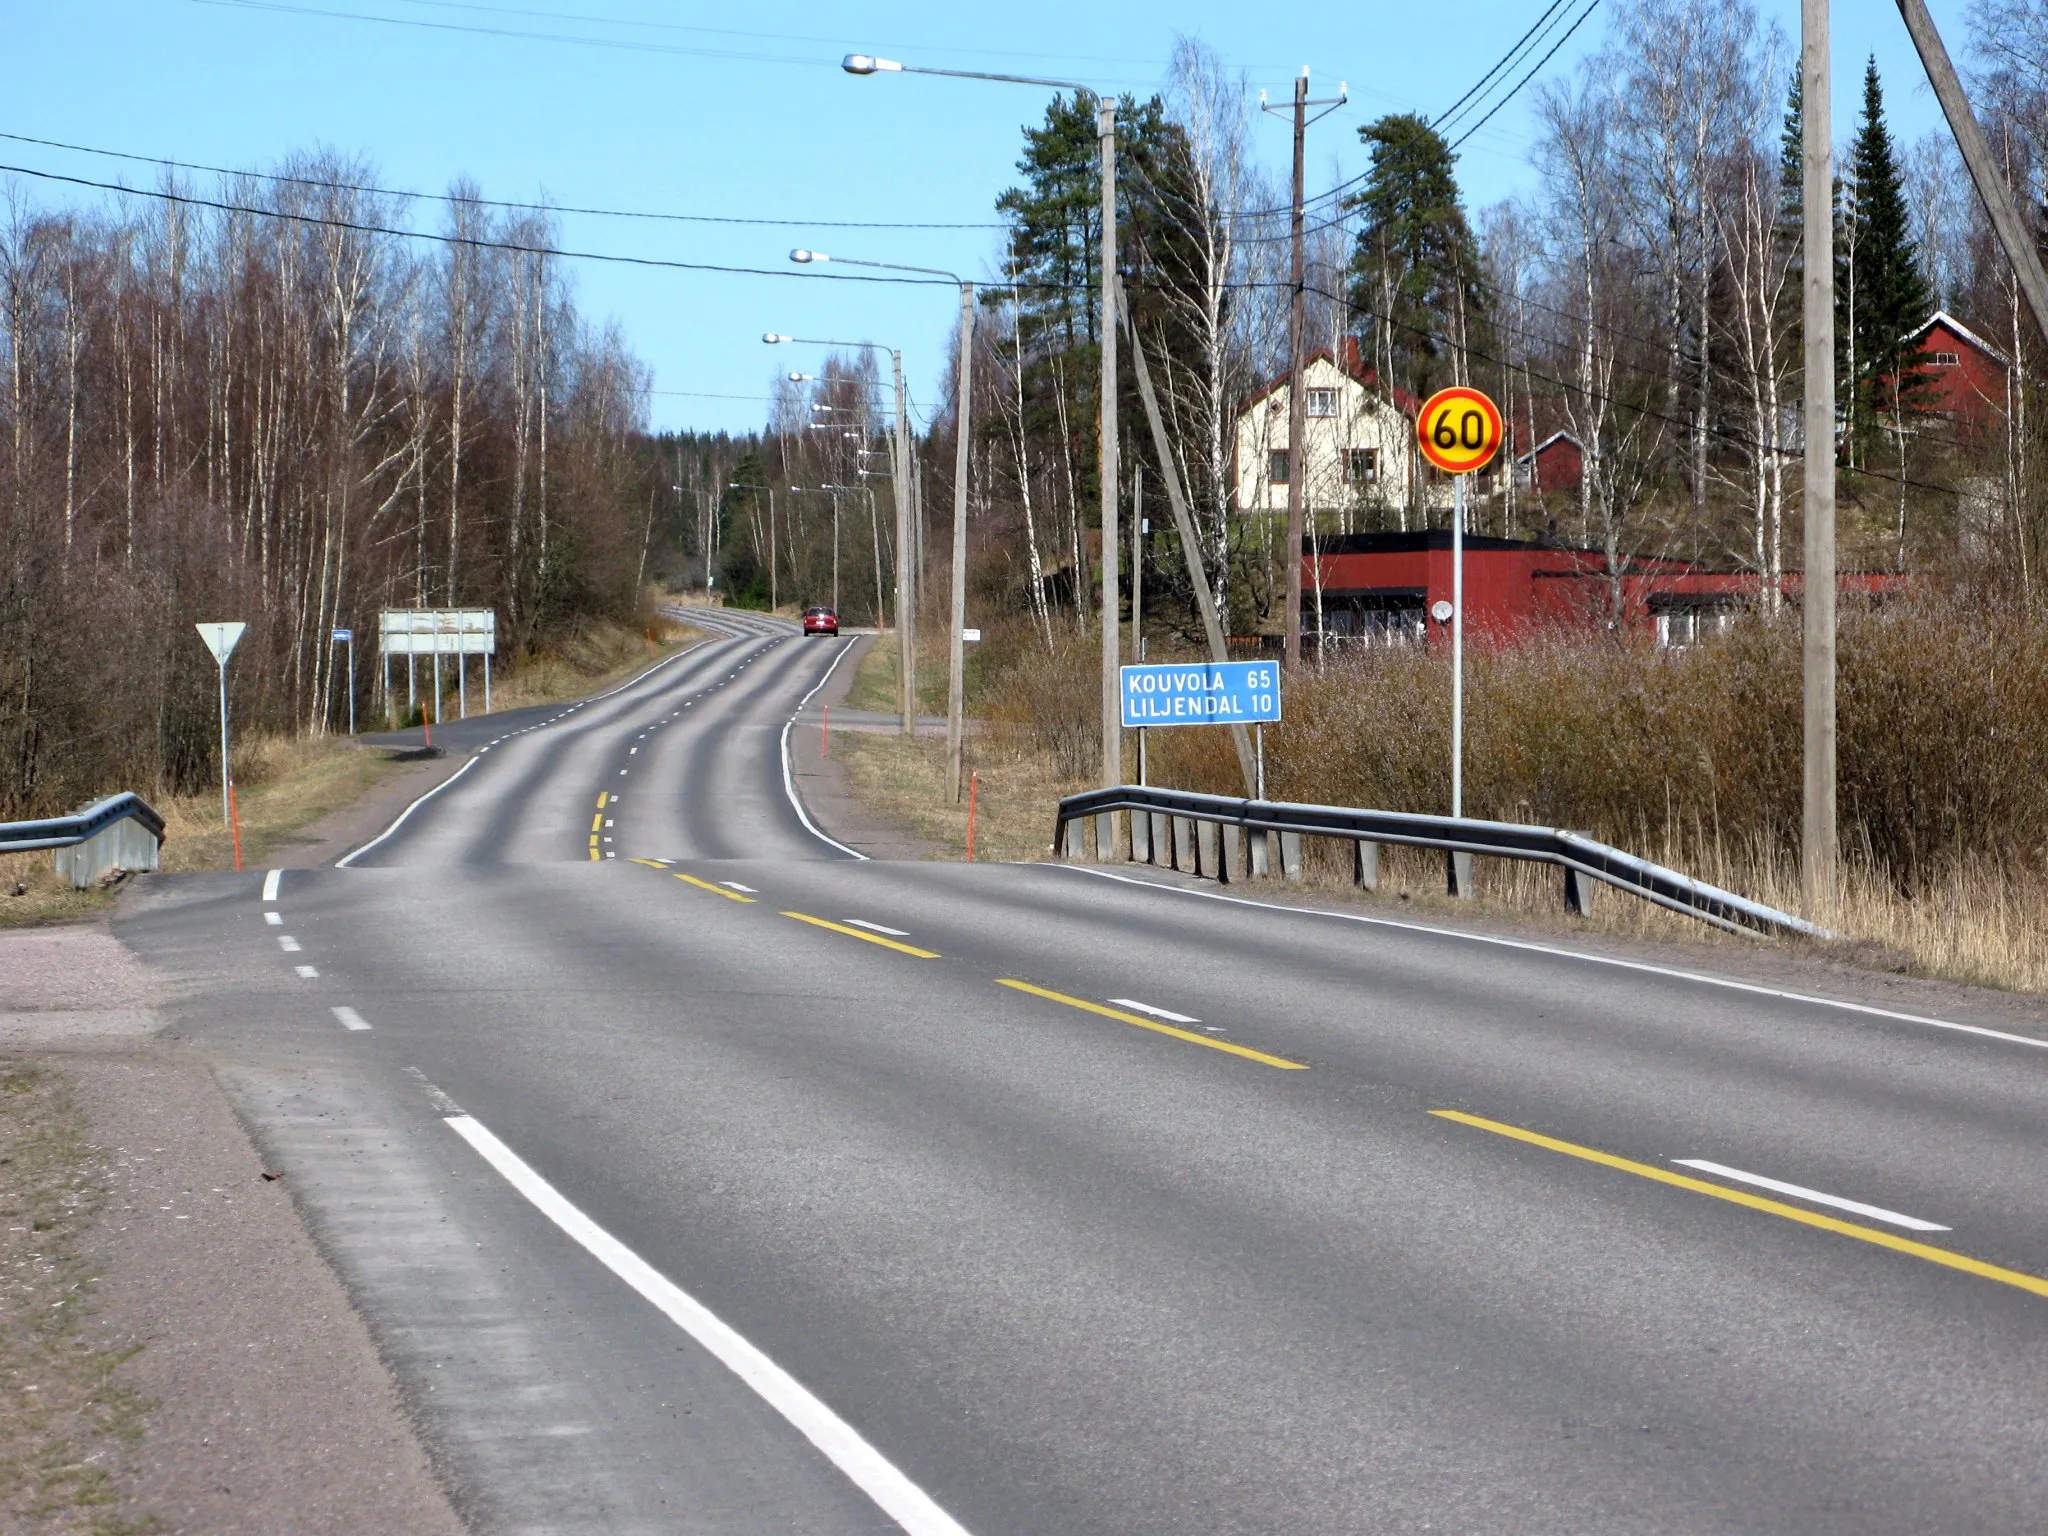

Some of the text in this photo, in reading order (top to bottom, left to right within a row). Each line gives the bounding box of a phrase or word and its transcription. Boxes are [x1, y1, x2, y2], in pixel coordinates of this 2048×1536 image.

[1434, 409, 1484, 450] 60
[1129, 670, 1271, 693] KOUVOLA 65
[1130, 694, 1272, 718] LILJENDAL 10
